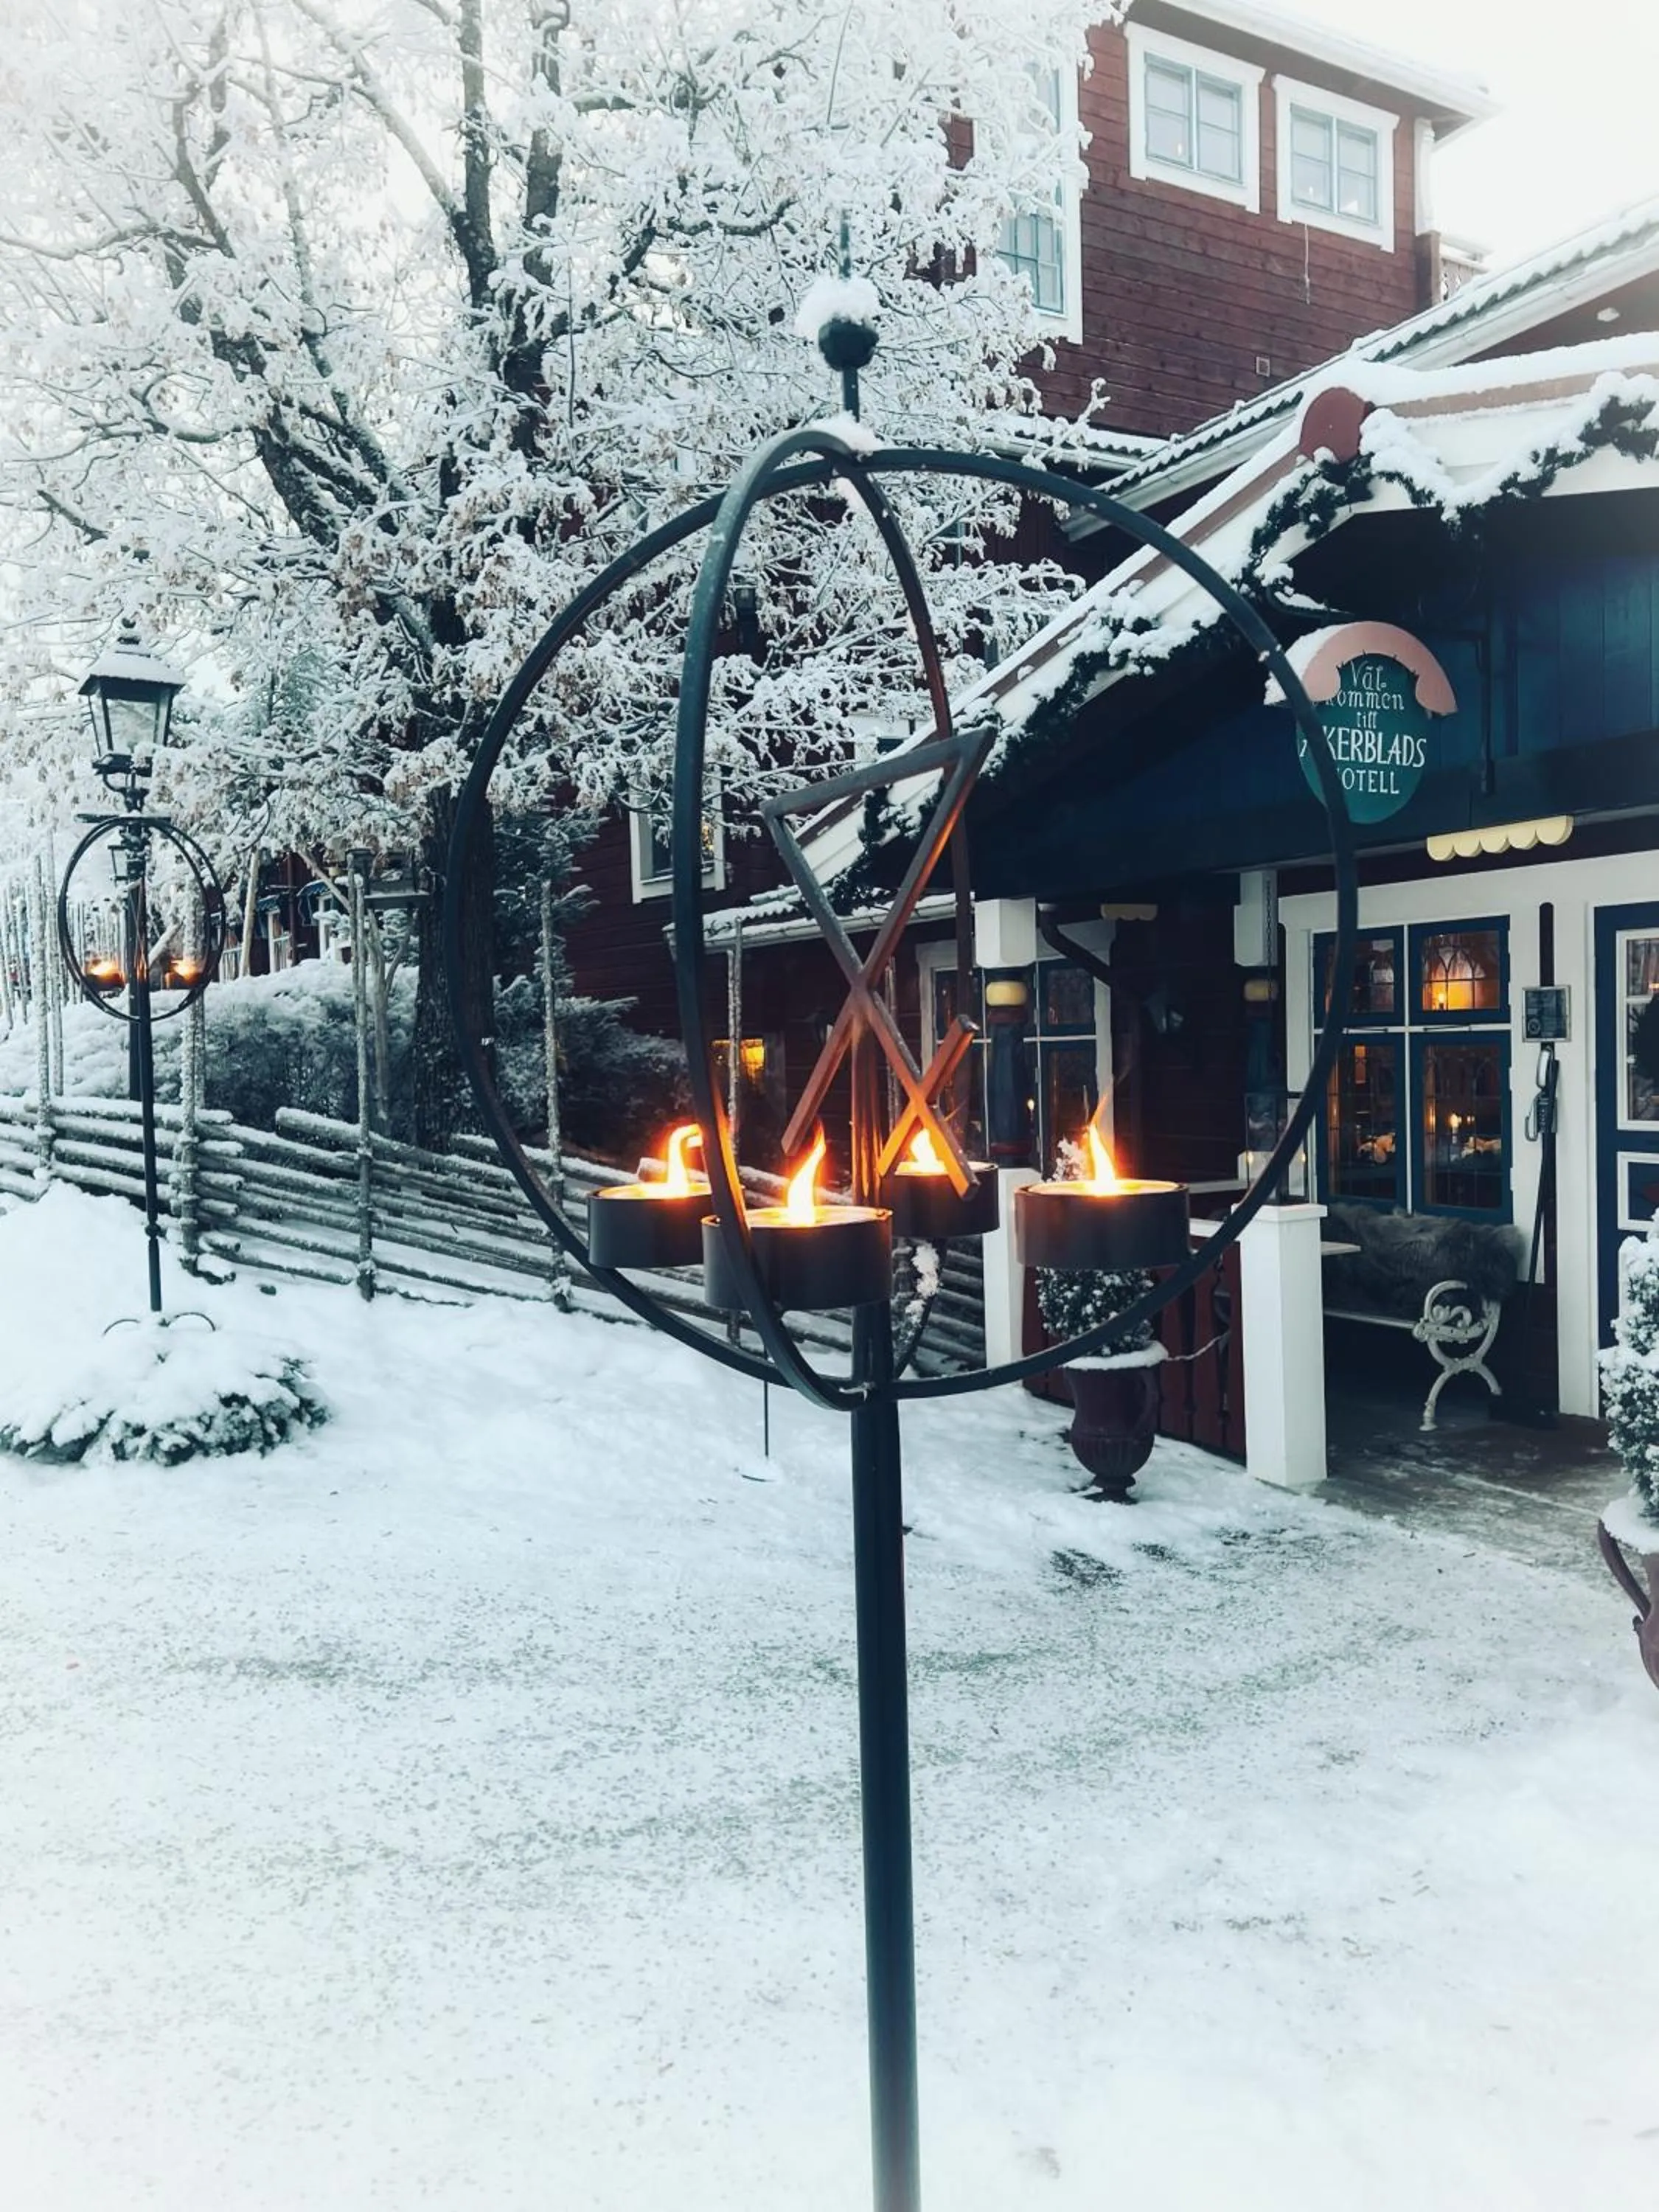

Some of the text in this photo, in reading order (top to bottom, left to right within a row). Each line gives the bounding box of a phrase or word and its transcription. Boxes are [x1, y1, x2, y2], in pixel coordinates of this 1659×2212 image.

[1325, 689, 1405, 711] ommen
[1356, 711, 1377, 729] till
[1336, 767, 1400, 795] OTELL
